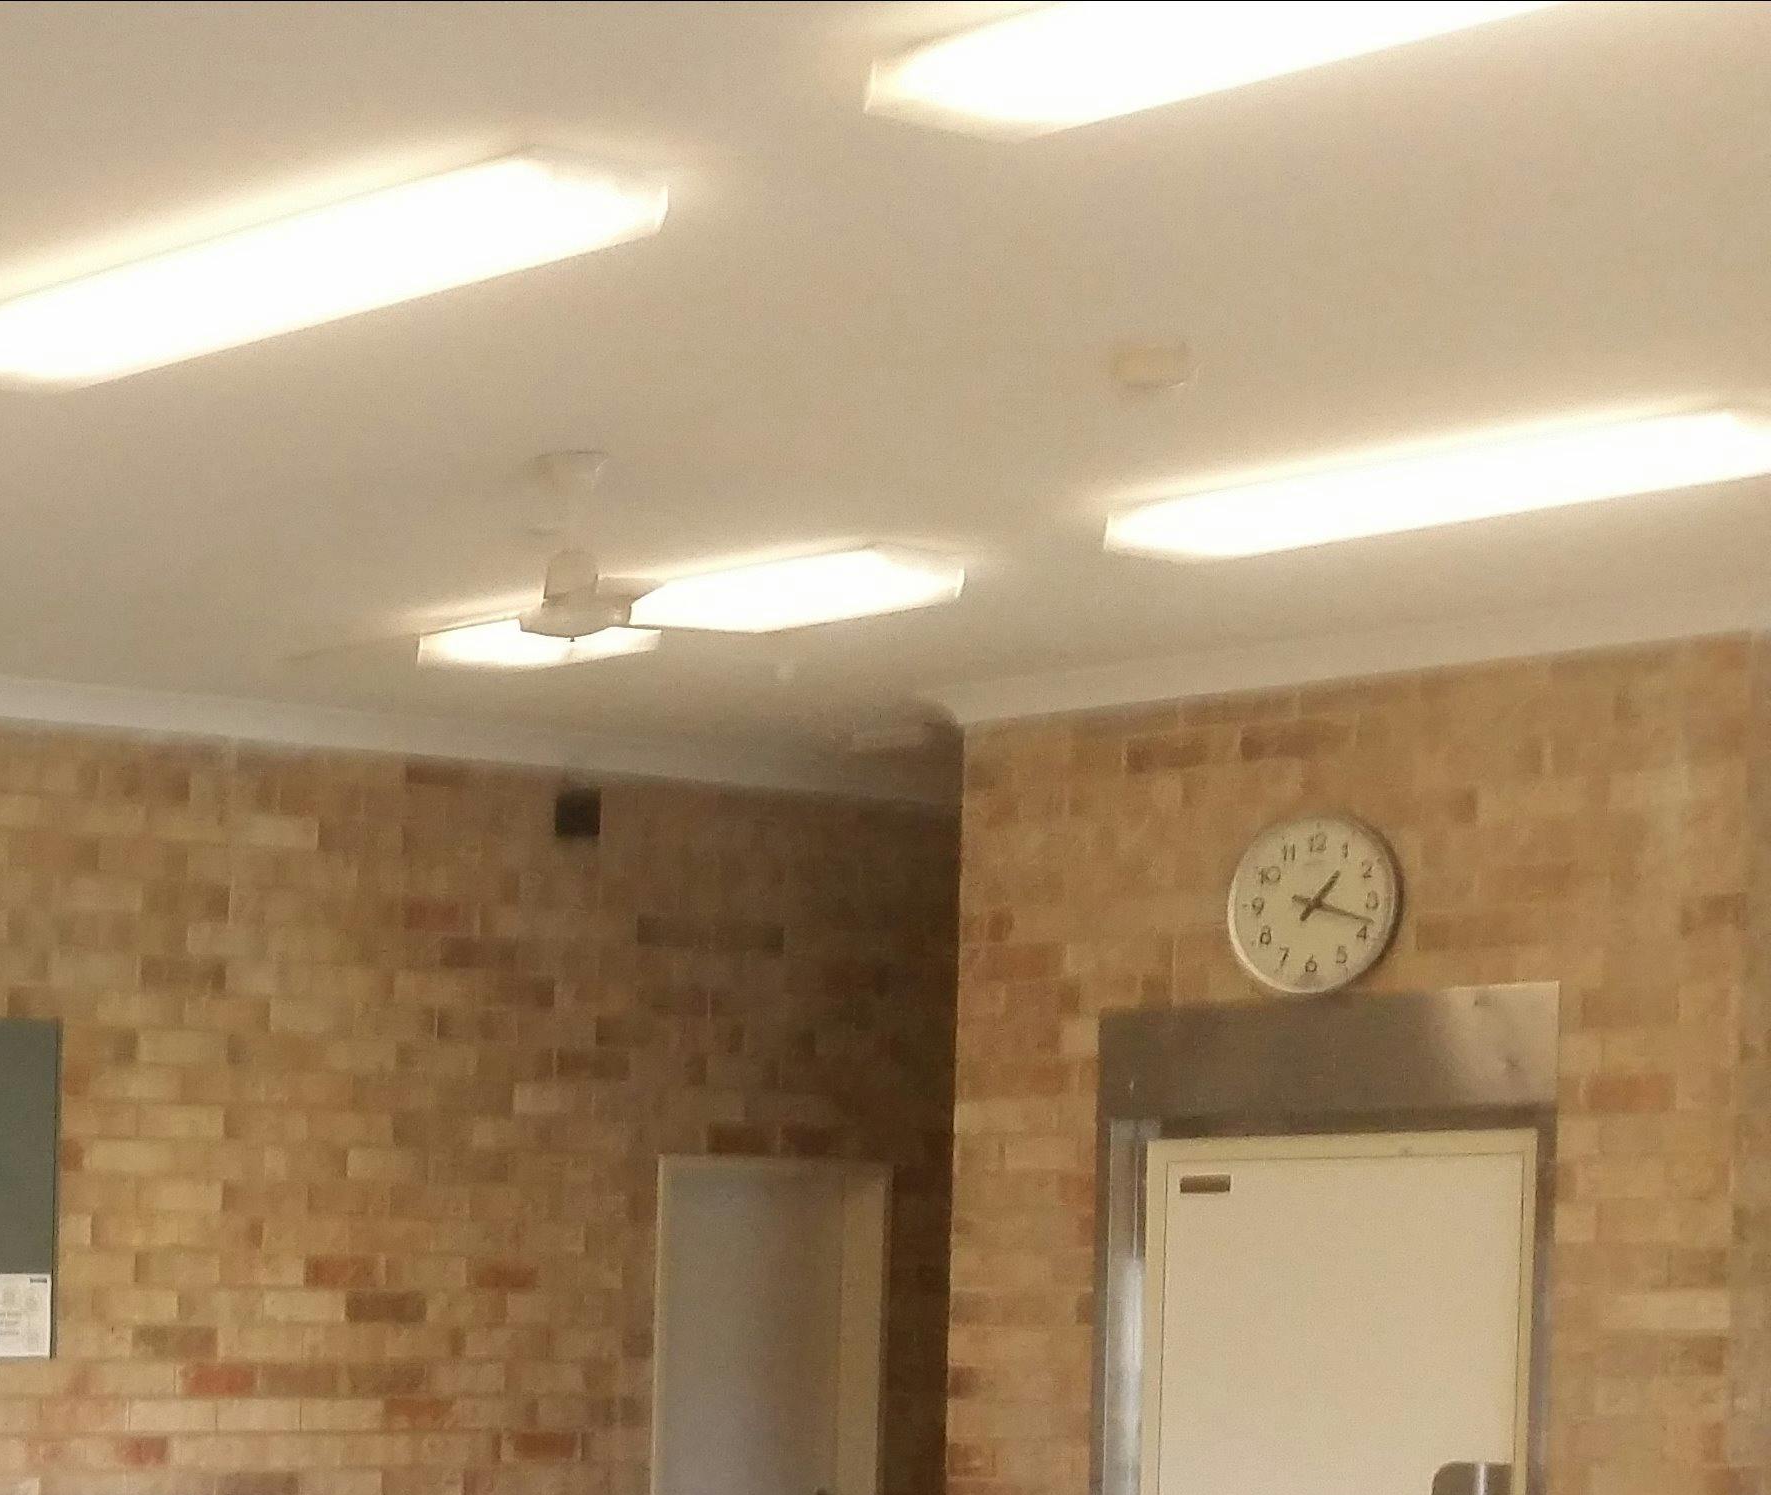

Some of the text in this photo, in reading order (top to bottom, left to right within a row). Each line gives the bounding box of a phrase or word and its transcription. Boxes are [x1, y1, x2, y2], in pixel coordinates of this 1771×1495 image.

[1310, 832, 1328, 853] 12
[1260, 865, 1281, 885] 10
[1361, 860, 1373, 879] 2
[1251, 897, 1265, 916] 9
[1259, 925, 1272, 946] 8
[1356, 925, 1368, 941] 4
[1278, 946, 1290, 968] 7
[1304, 953, 1318, 974] 6
[1335, 945, 1348, 964] 5
